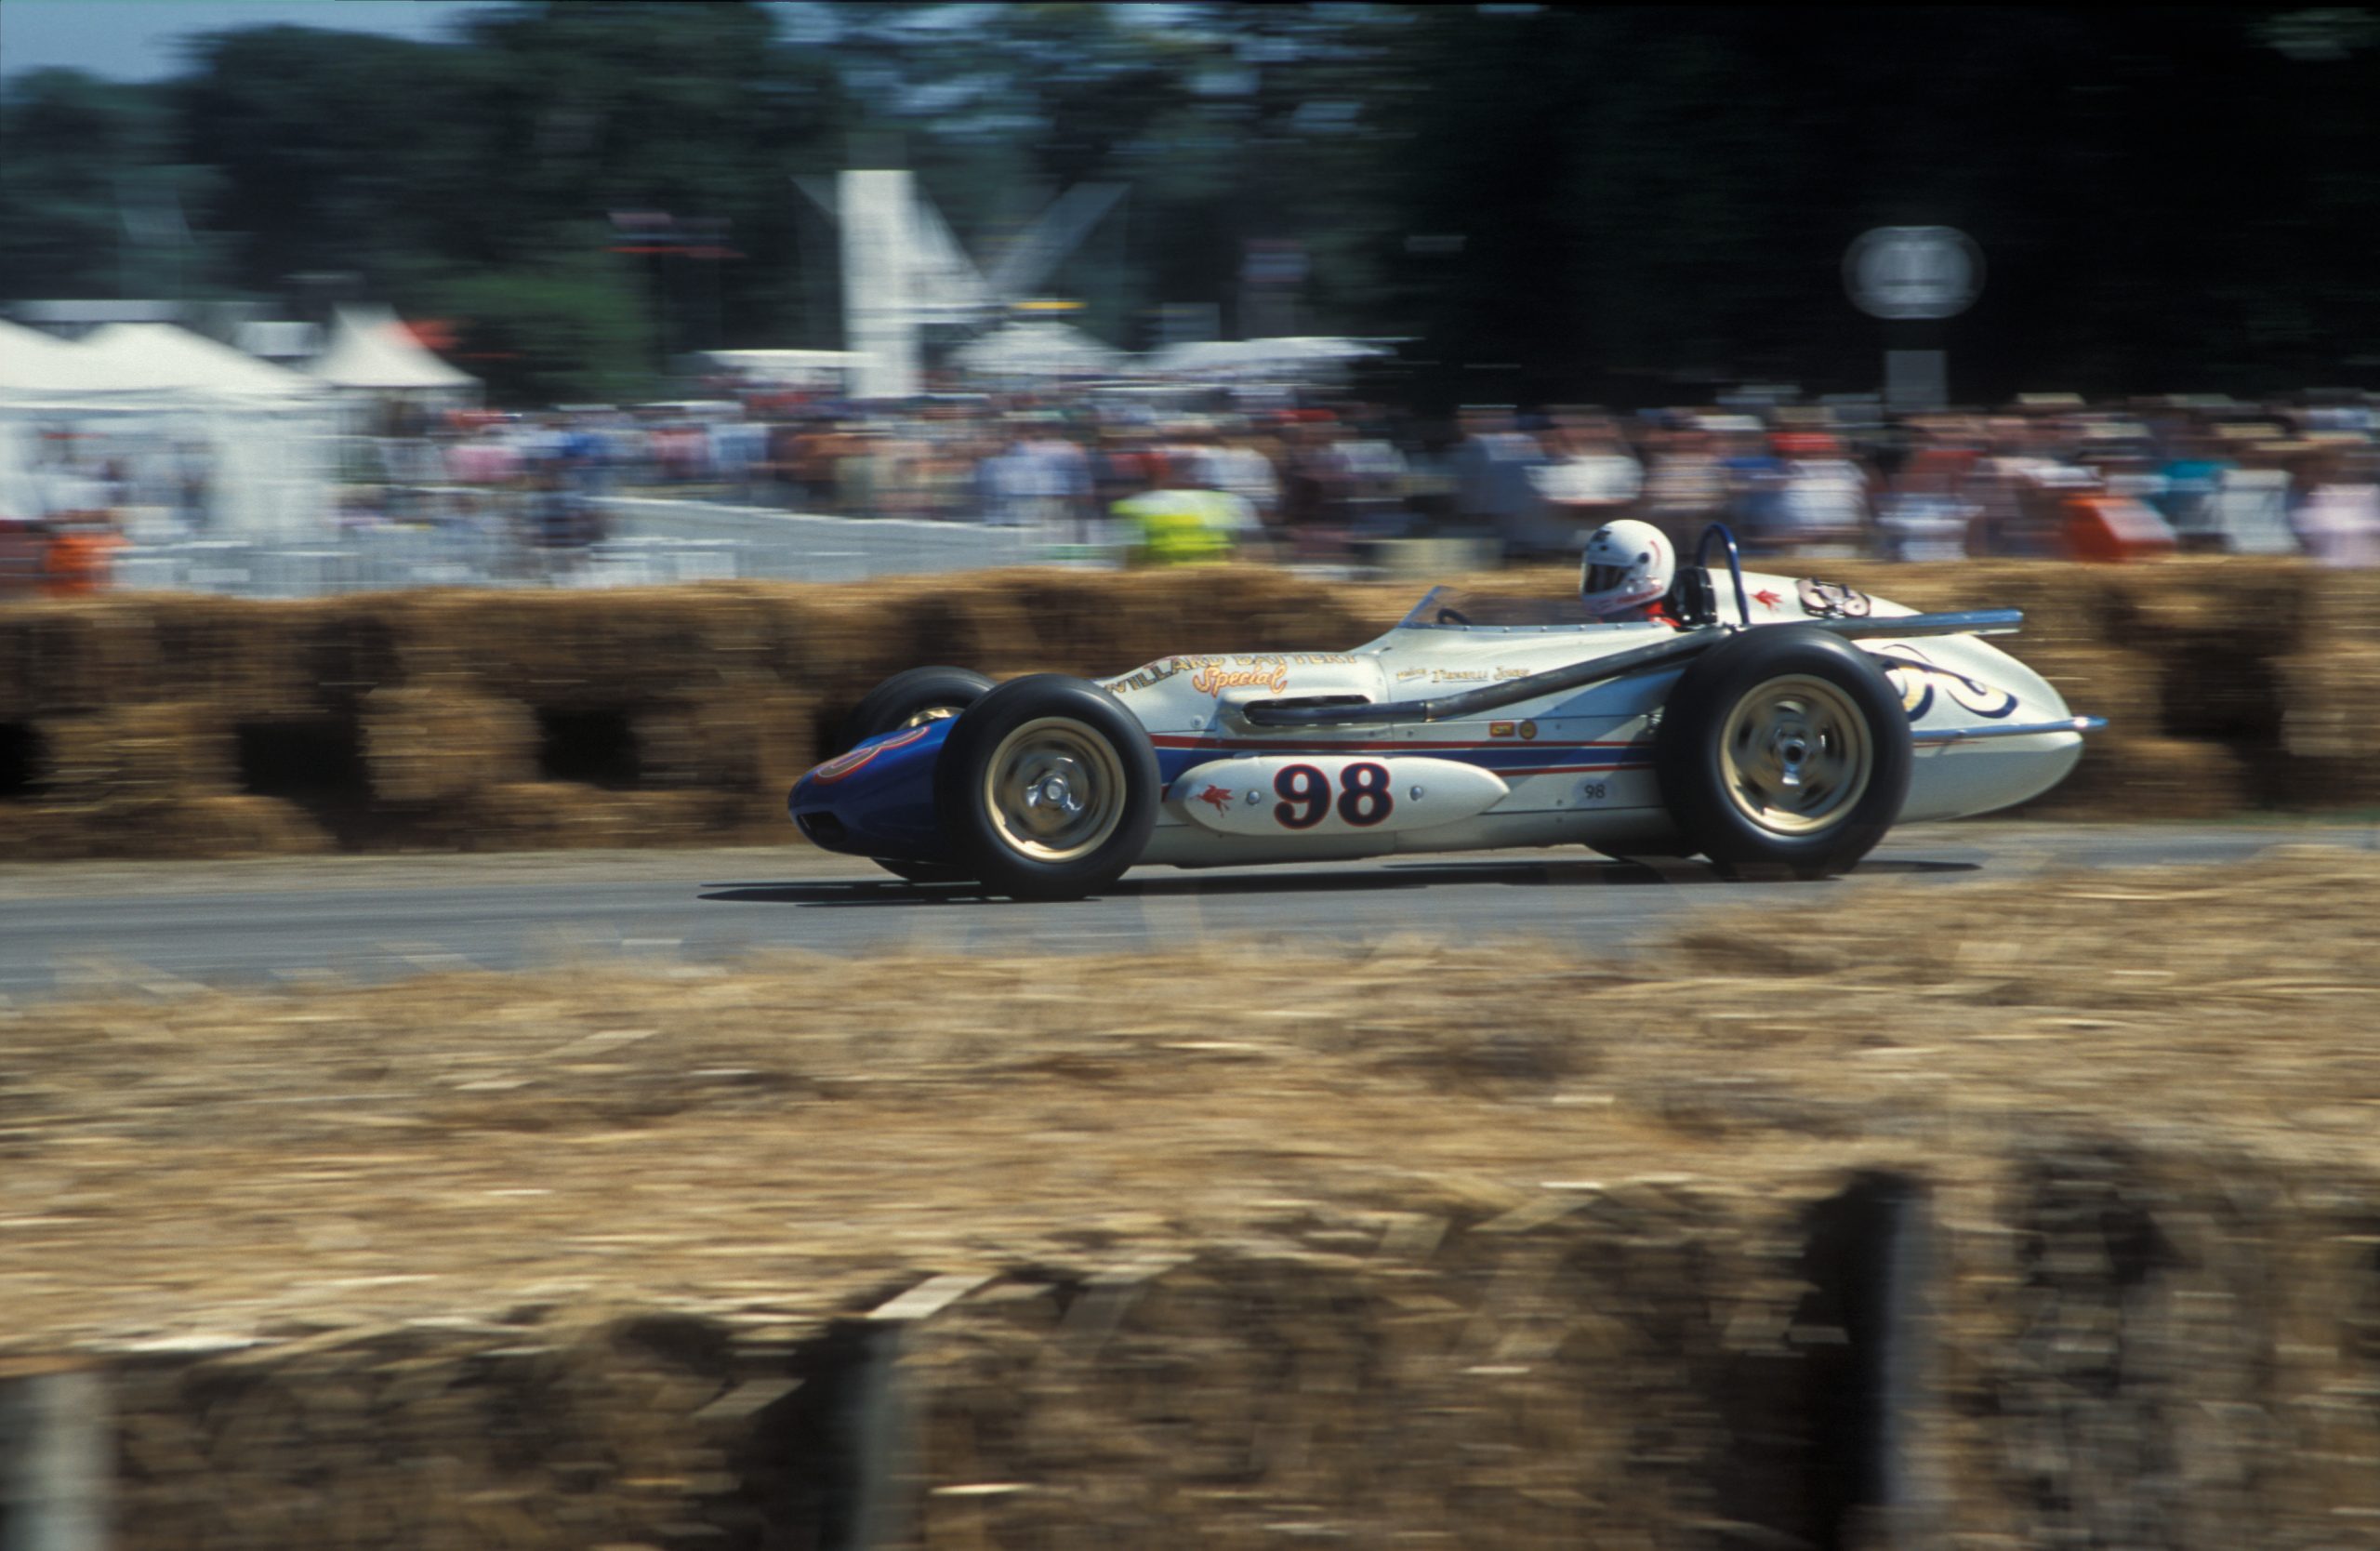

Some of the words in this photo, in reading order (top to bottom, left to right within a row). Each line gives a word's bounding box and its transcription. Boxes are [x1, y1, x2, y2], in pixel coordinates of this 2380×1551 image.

[1193, 662, 1288, 698] Special
[1273, 762, 1395, 830] 98
[1584, 783, 1606, 800] 98
